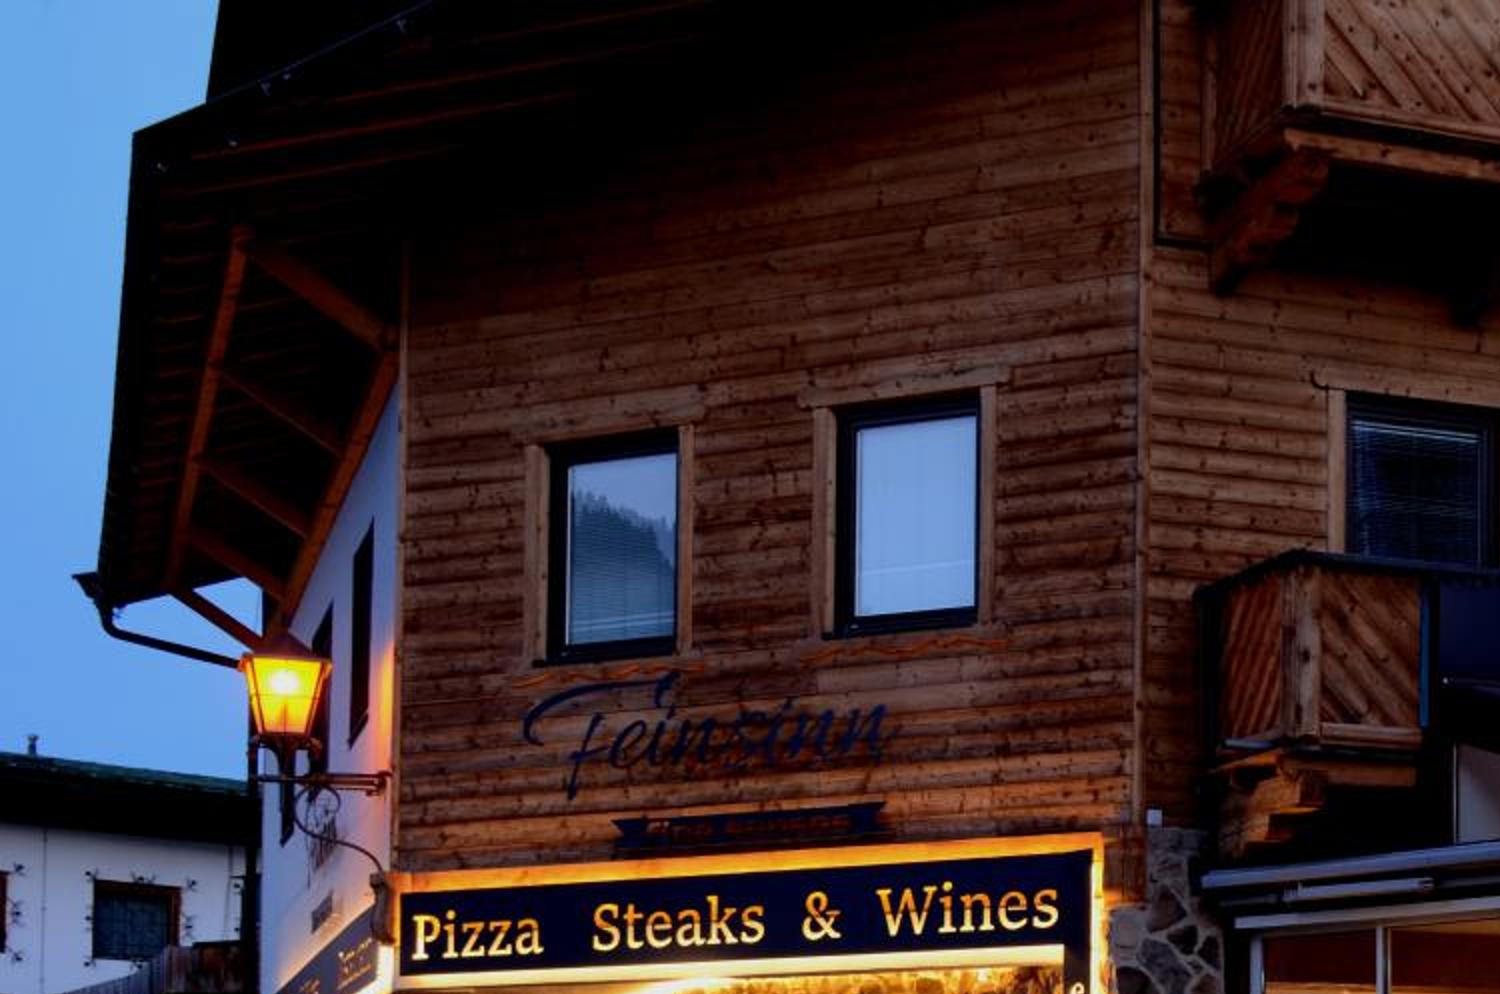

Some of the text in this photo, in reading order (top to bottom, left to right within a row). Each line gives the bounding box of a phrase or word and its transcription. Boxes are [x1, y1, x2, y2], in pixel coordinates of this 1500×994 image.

[523, 672, 895, 800] Feinsinn
[411, 881, 1060, 960] Pizza Steaks & Wines
